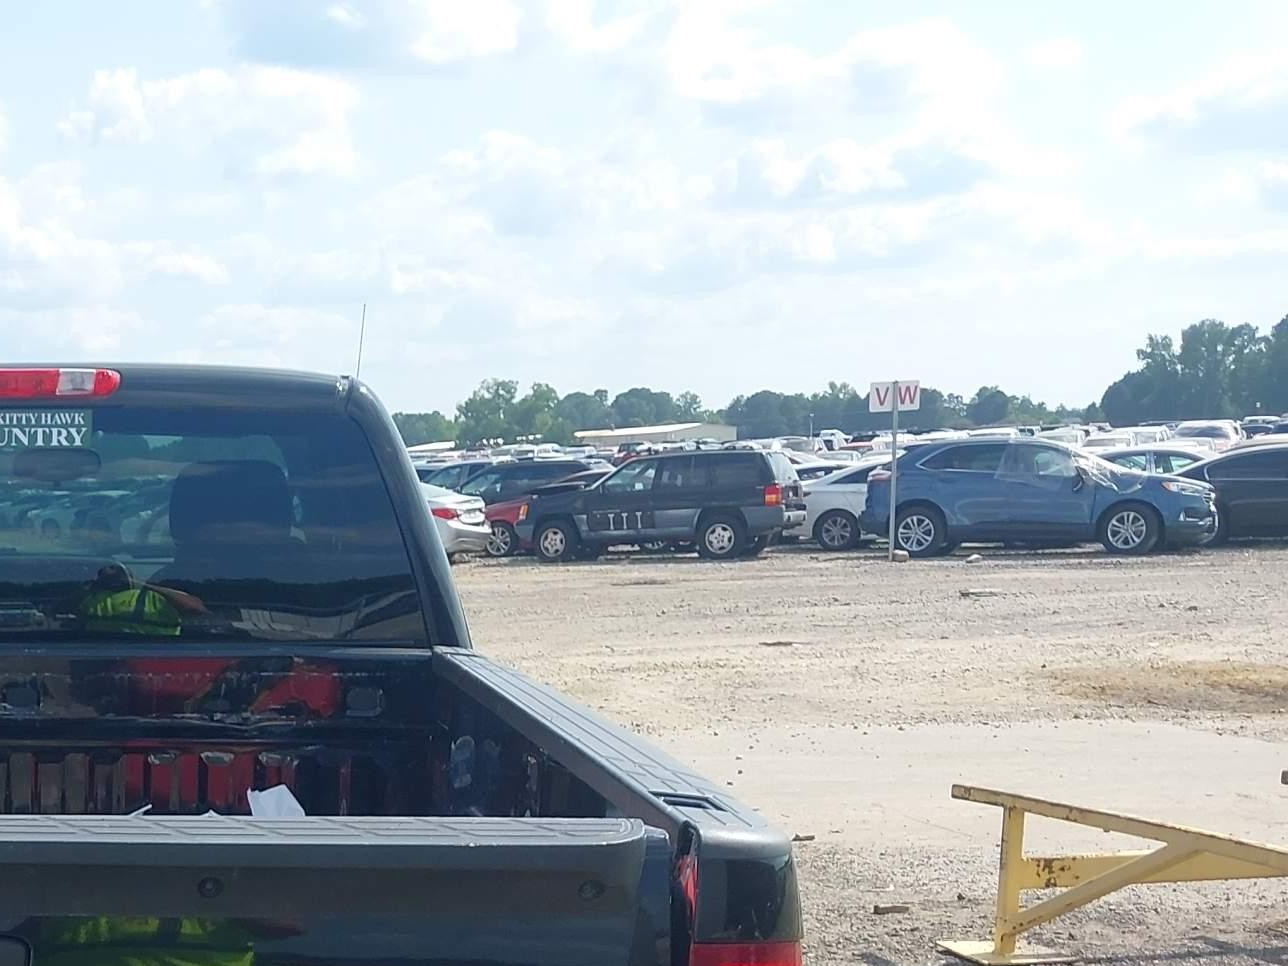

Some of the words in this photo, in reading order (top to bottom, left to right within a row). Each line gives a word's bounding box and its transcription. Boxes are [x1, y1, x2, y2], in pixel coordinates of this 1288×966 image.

[875, 386, 890, 407] V
[898, 385, 918, 405] W
[41, 412, 85, 425] HAWK
